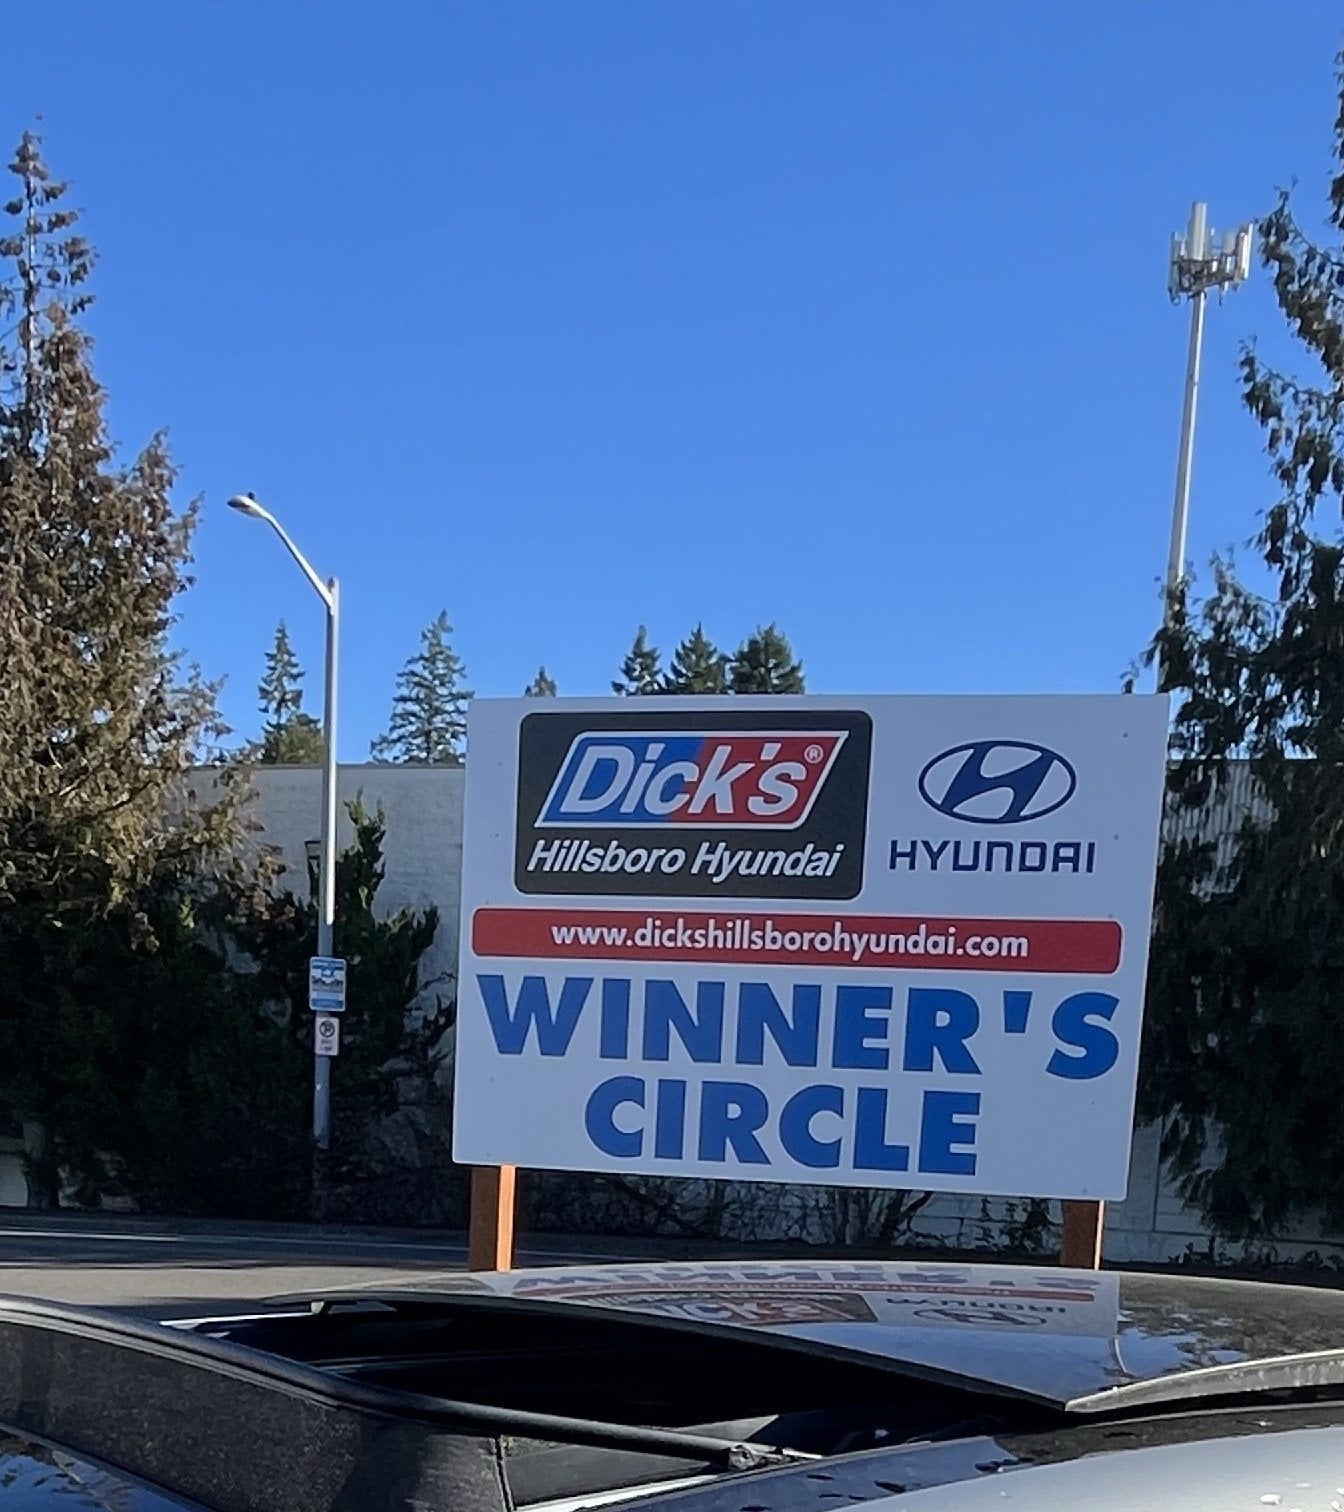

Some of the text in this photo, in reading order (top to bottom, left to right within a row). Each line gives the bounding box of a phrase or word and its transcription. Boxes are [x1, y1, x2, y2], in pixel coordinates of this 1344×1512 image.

[526, 839, 845, 884] Hillsboro Hyundai
[888, 839, 1095, 875] HYUNDAI
[551, 917, 1029, 962] www.dickshillsborohyundai.com
[475, 974, 1121, 1081] WINNER'S
[584, 1076, 981, 1176] CIRCLE
